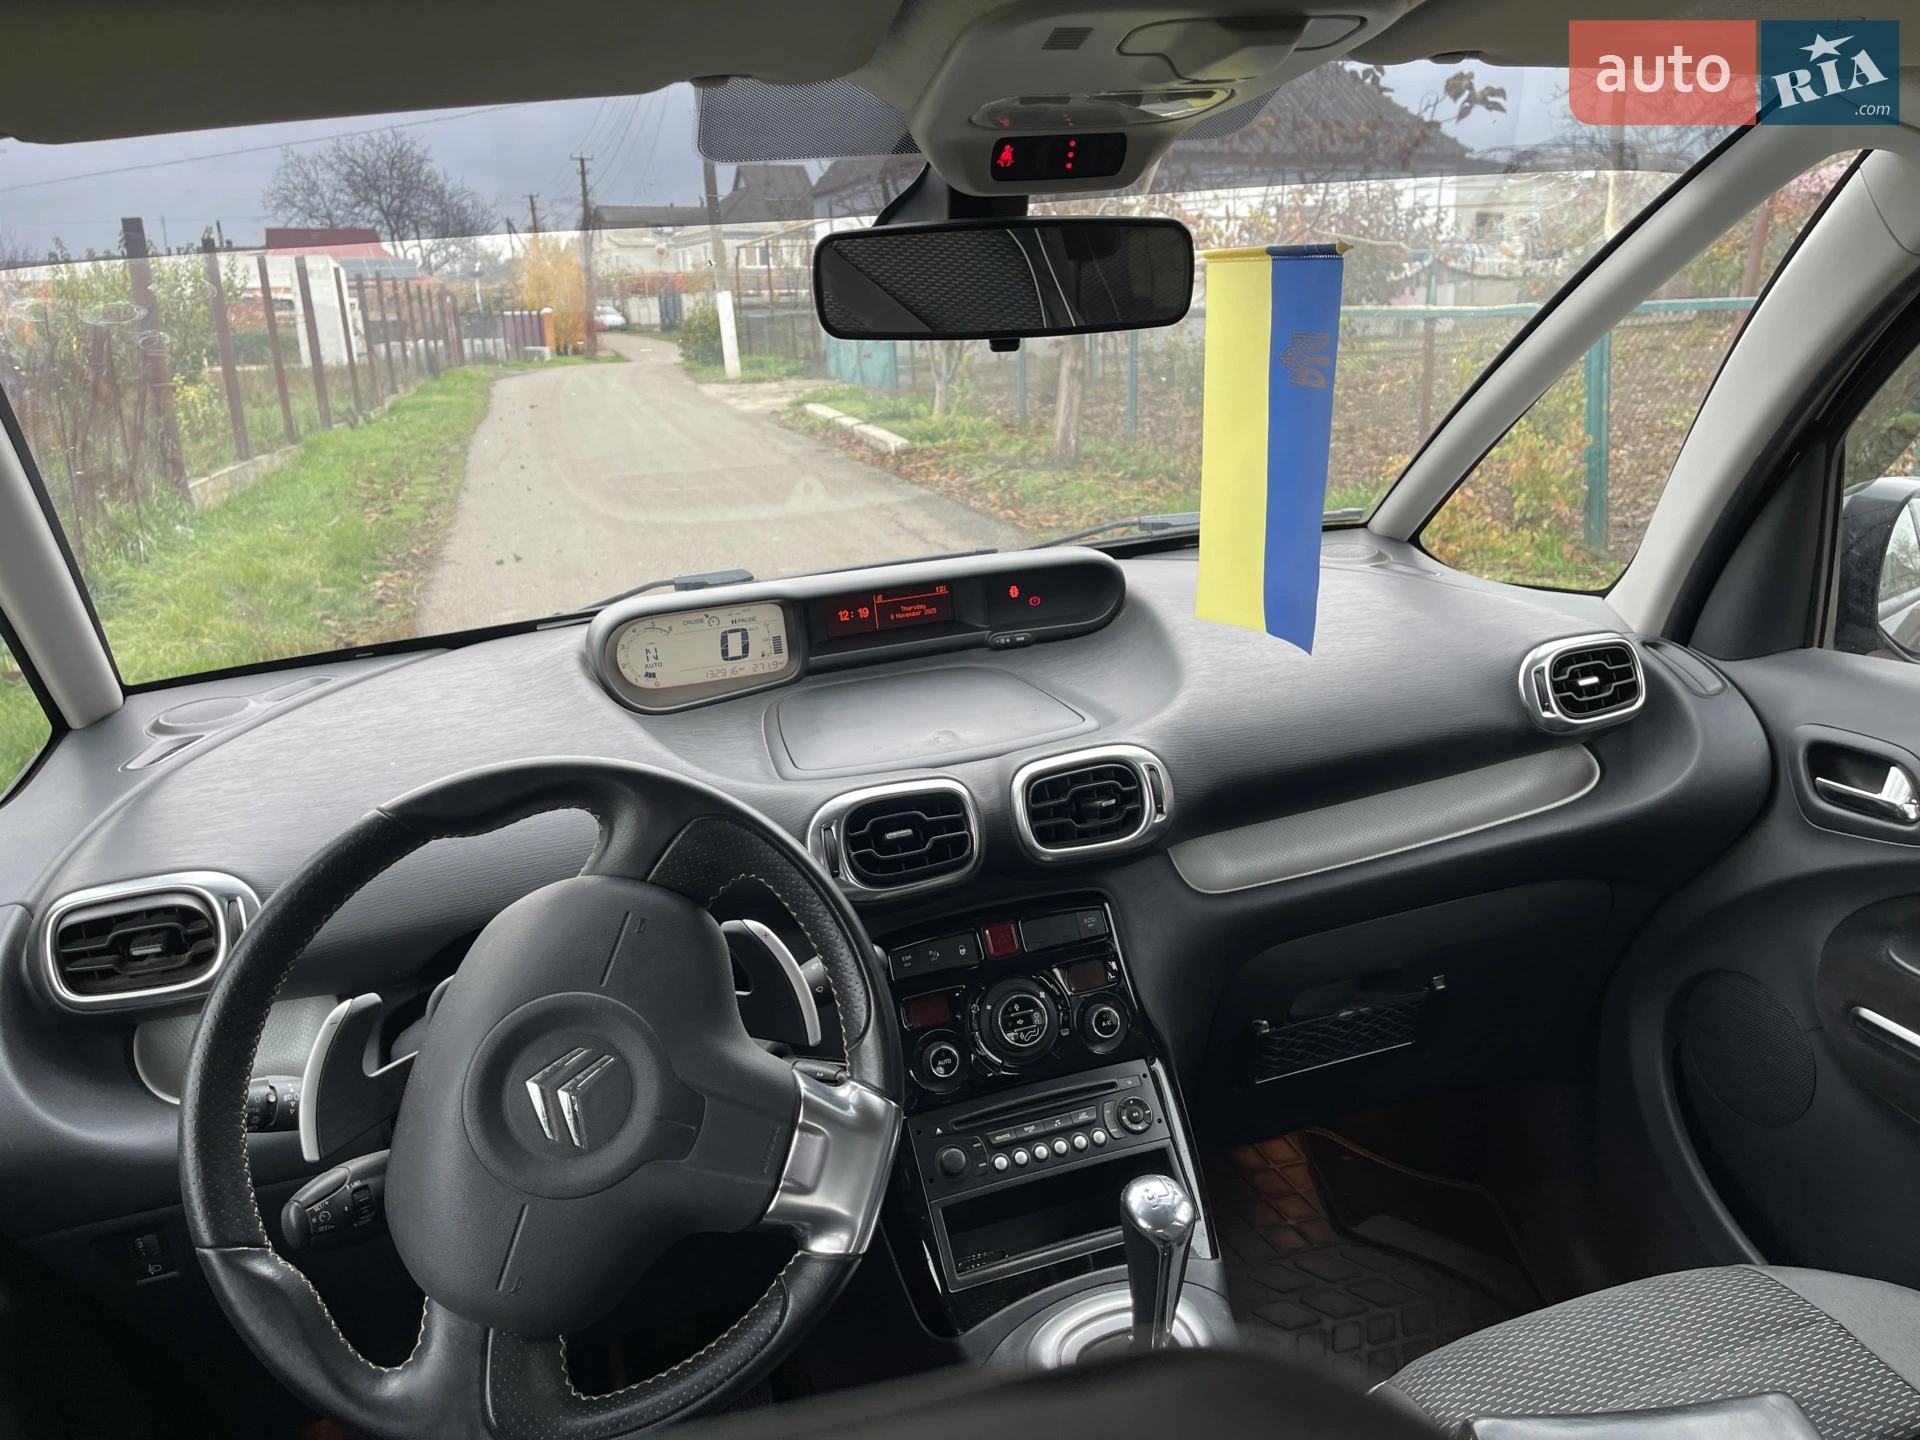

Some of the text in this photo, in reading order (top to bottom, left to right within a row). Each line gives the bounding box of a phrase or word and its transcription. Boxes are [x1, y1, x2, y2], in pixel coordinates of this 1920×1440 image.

[896, 610, 922, 619] November
[682, 618, 705, 626] CRUISE
[720, 627, 750, 662] 0
[644, 661, 663, 670] AUTO
[705, 666, 739, 679] 132916
[937, 1058, 952, 1066] AUTO
